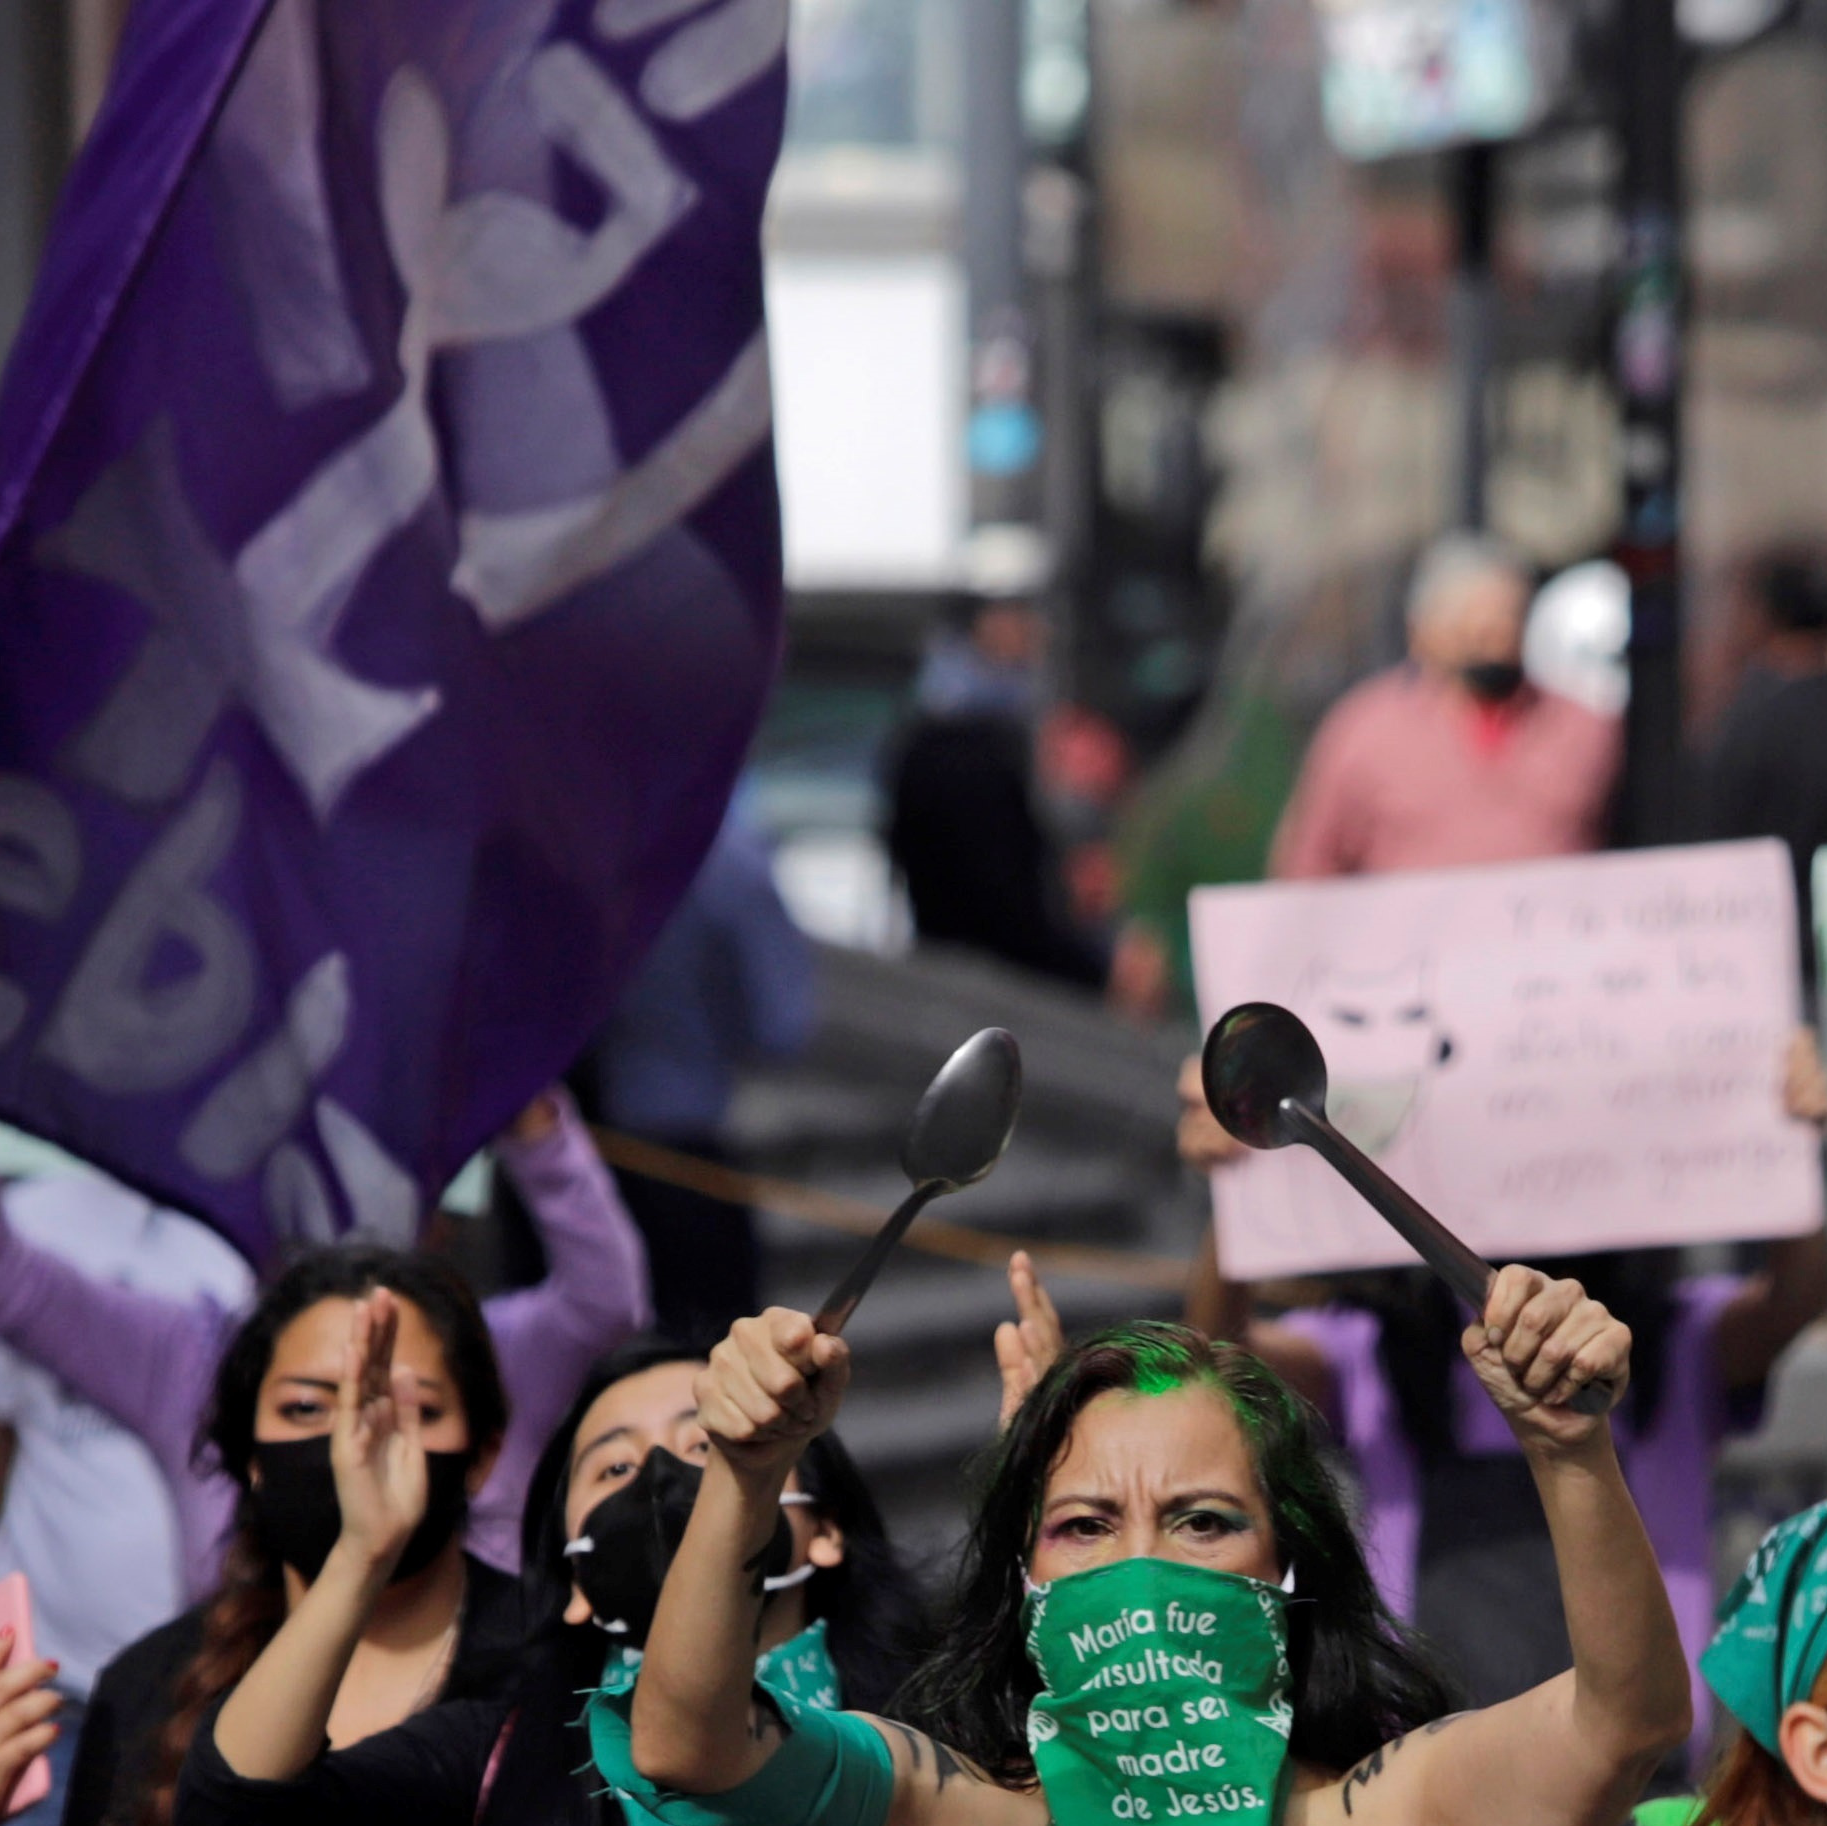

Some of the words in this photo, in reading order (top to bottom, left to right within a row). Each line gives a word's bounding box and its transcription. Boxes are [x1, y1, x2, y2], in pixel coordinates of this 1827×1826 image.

[1069, 1606, 1156, 1664] María
[1166, 1600, 1219, 1636] fue
[1086, 1706, 1171, 1739] para
[1116, 1739, 1227, 1777] madre
[1111, 1787, 1153, 1821] de
[1166, 1783, 1266, 1818] Jesús.
